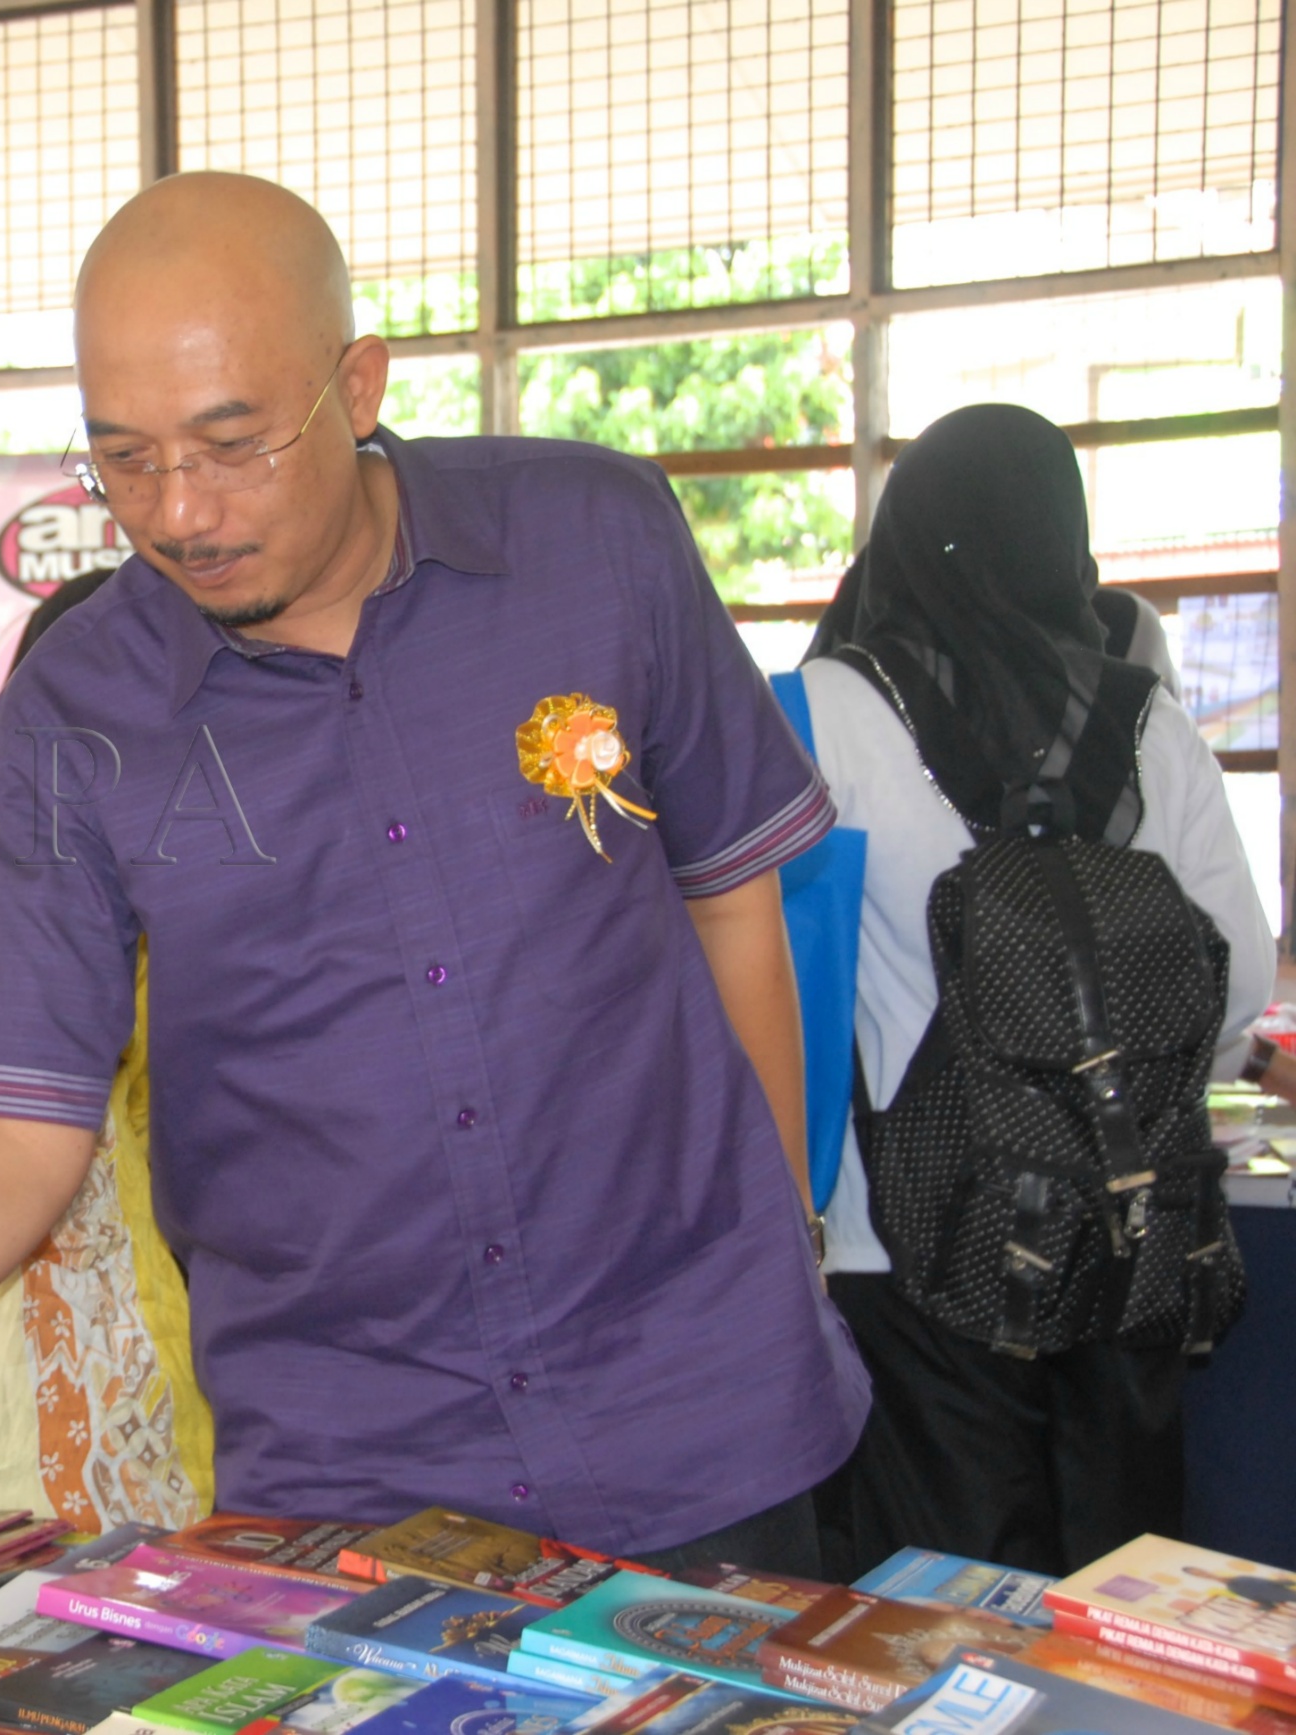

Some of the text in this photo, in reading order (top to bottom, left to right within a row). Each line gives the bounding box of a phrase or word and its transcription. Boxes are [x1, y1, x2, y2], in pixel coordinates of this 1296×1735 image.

[68, 1598, 99, 1619] Urus
[100, 1606, 142, 1630] Bisnes
[1087, 1605, 1113, 1626] PIKAT
[1113, 1613, 1151, 1635] REMAJA
[1099, 1626, 1126, 1648] PIKAT
[1127, 1634, 1165, 1656] REMAJA
[779, 1655, 824, 1680] Mukjizat
[784, 1674, 827, 1699] Mukjizat
[198, 1682, 298, 1724] ISLAM
